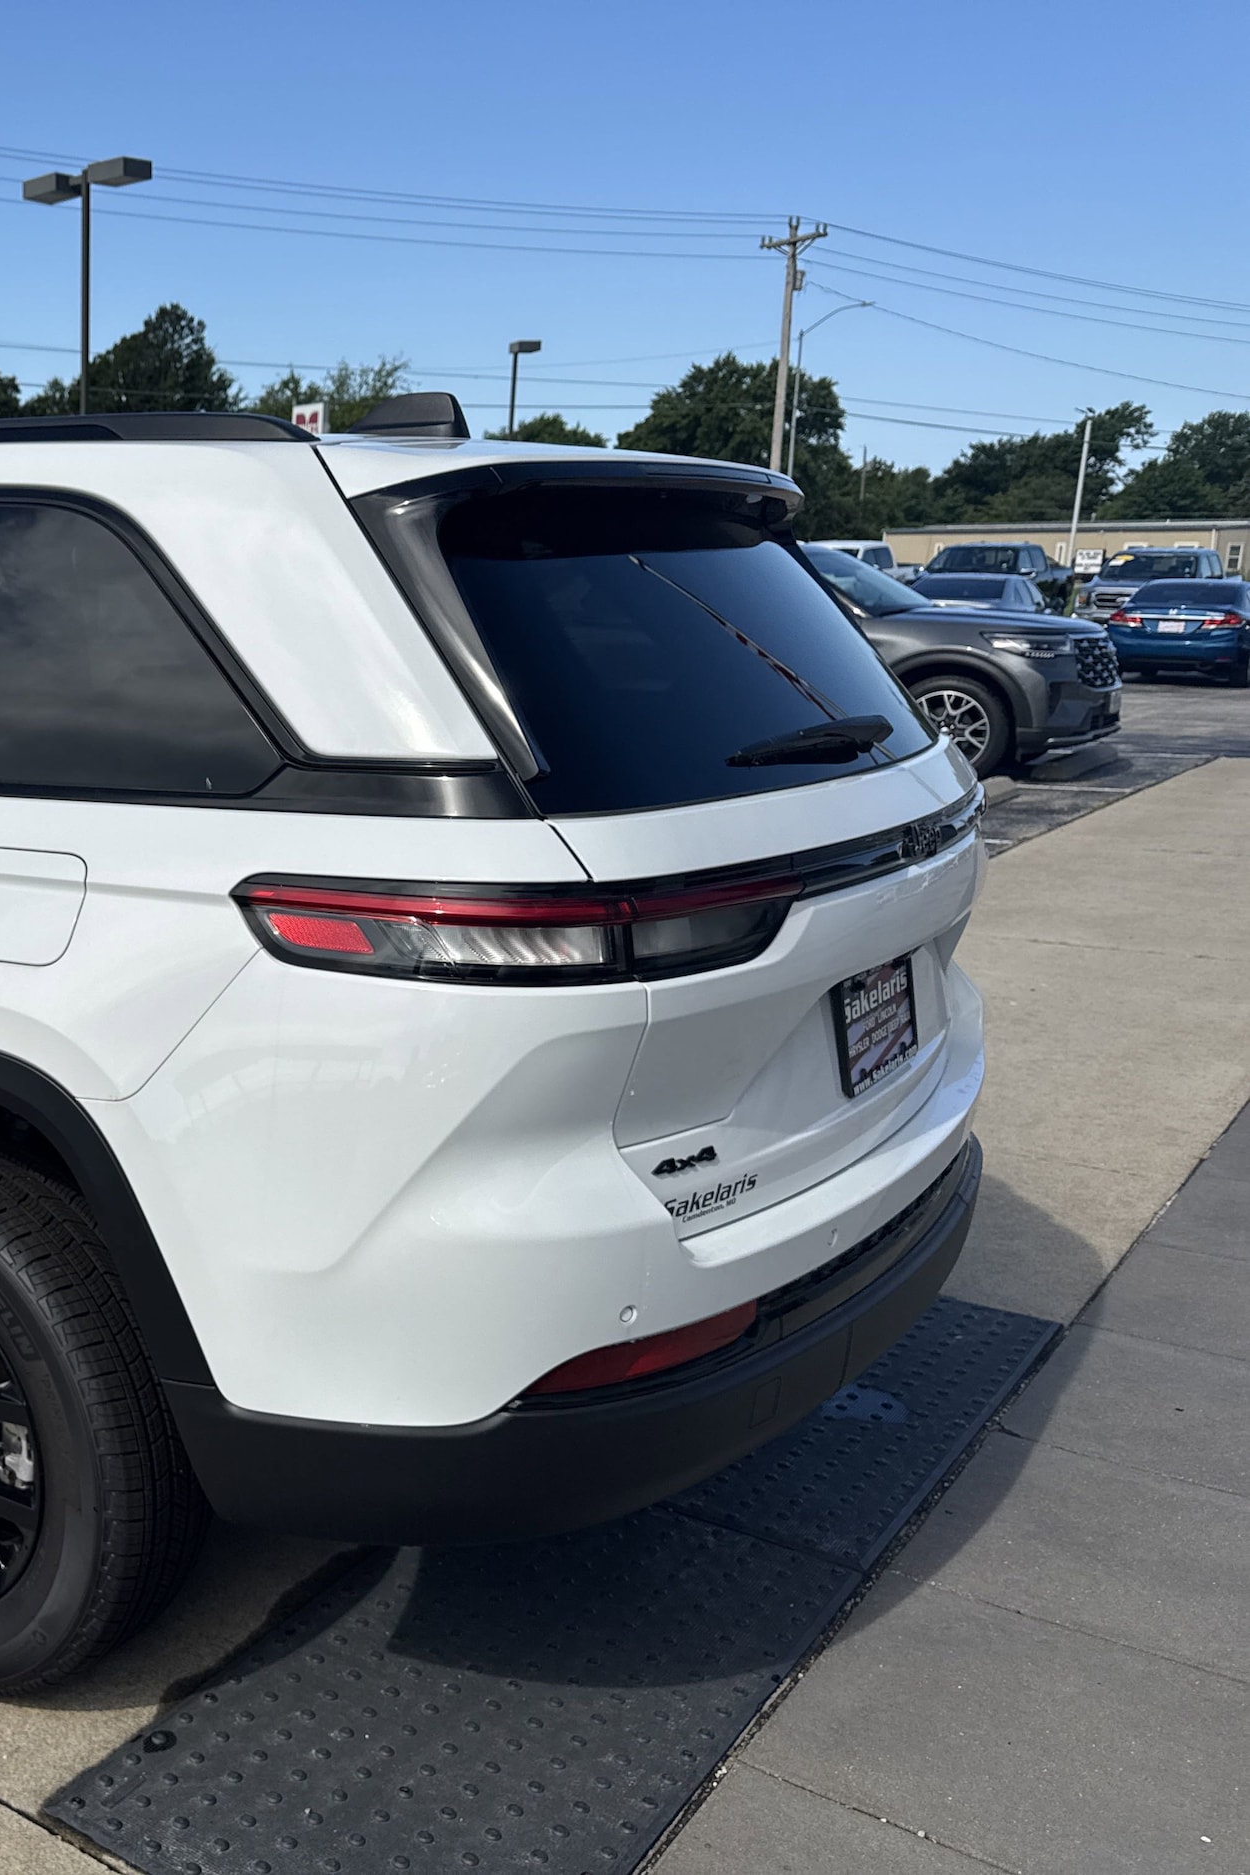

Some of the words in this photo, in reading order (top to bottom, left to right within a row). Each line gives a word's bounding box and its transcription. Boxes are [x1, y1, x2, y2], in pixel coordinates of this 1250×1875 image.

[844, 970, 908, 1024] Sakelaris
[651, 1146, 717, 1176] 4x4
[664, 1173, 758, 1217] Sakelaris
